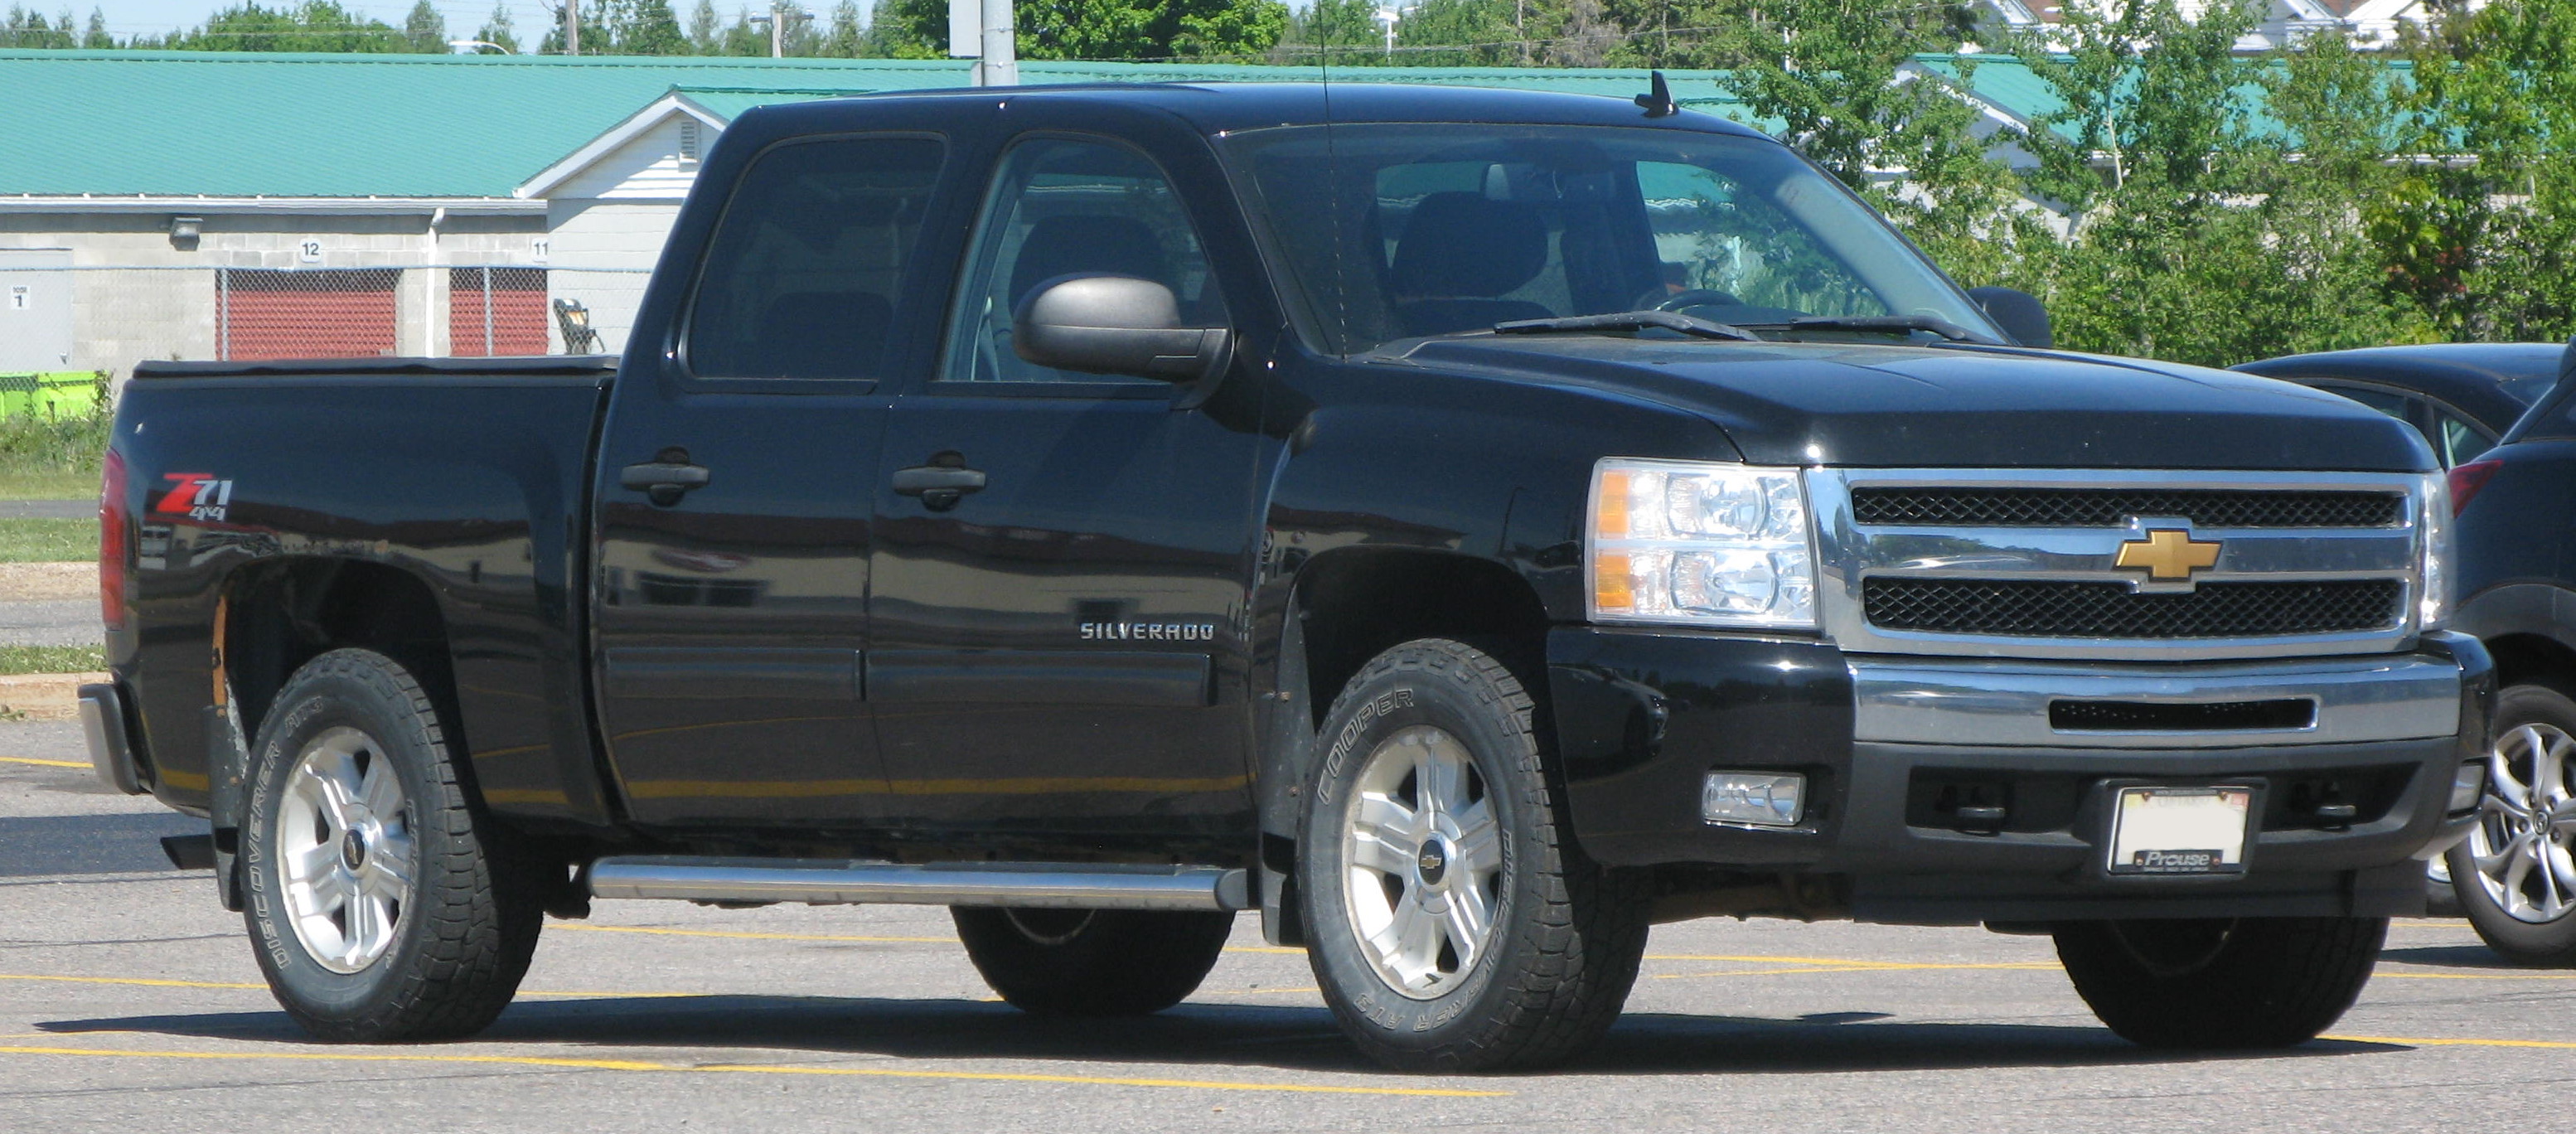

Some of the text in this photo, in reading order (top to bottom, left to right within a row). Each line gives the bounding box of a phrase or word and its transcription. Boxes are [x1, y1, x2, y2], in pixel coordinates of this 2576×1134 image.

[302, 242, 320, 256] 12
[534, 242, 549, 256] 11
[14, 294, 22, 308] 1
[156, 472, 232, 512] Z71
[1080, 623, 1214, 641] SILVERADO
[1317, 688, 1414, 806] COOPER
[249, 740, 292, 971] DISCOVERER
[2144, 850, 2210, 867] Prouse
[1353, 991, 1407, 1030] AT3
